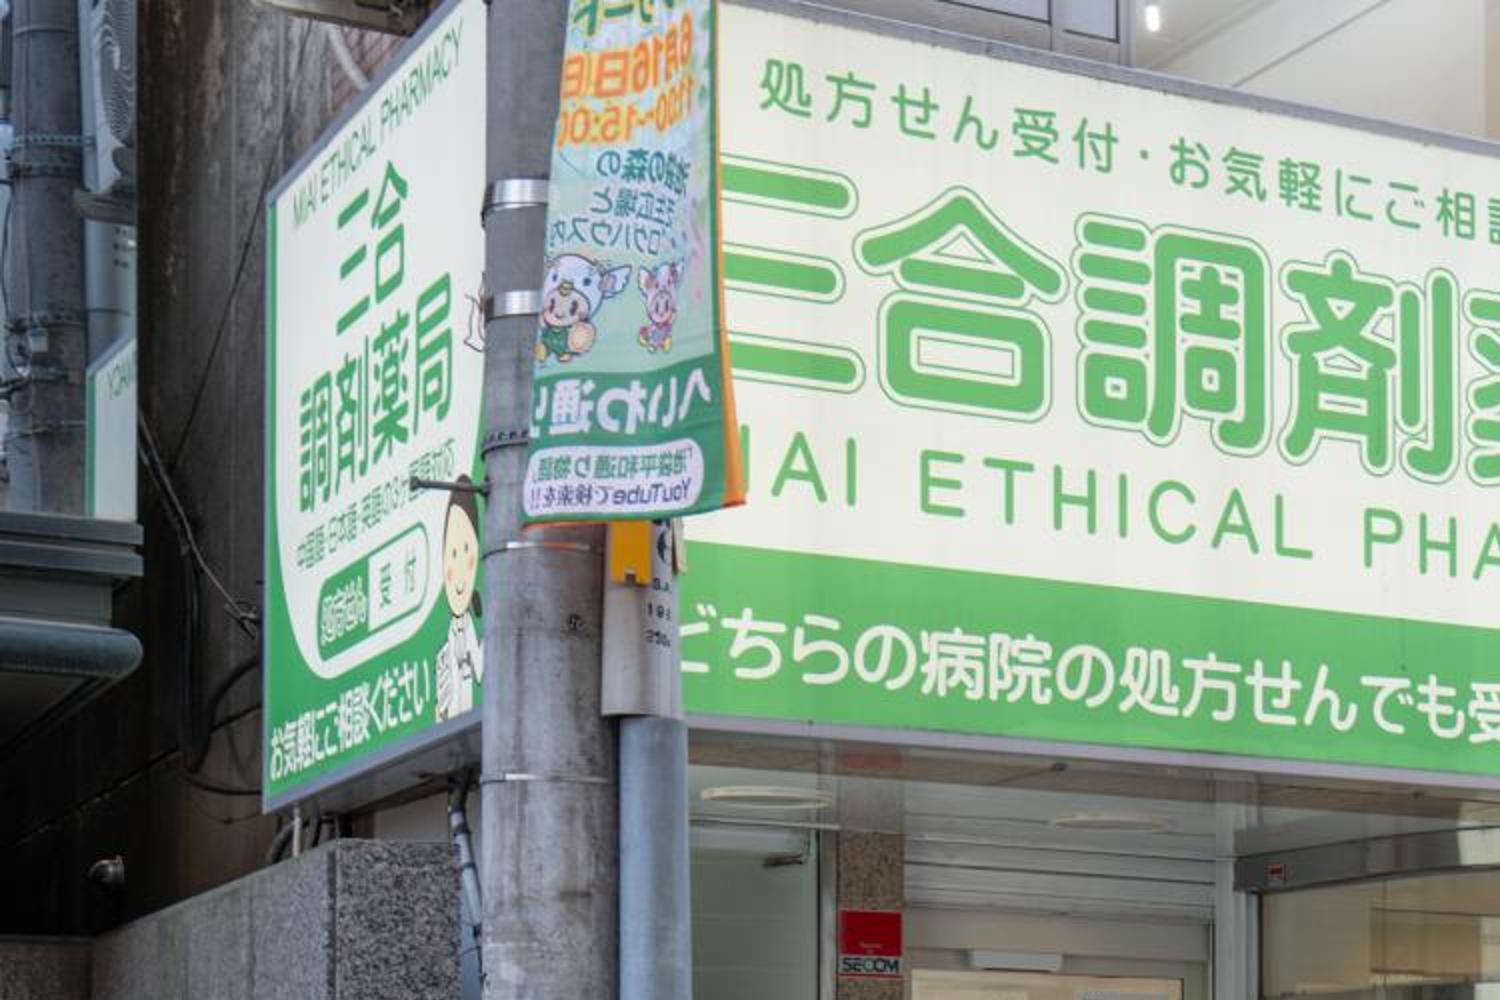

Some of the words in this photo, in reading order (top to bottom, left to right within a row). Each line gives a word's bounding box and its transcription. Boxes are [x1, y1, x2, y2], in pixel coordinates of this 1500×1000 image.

[321, 116, 377, 200] ETHICAL
[380, 16, 463, 132] PHARMACY
[337, 162, 409, 338] 三合
[300, 270, 454, 513] 調剤薬局
[739, 424, 857, 507] IAI
[920, 448, 1313, 560] ETHICAL
[270, 660, 432, 779] お気軽にご相談ください
[842, 957, 899, 974] SECOM
